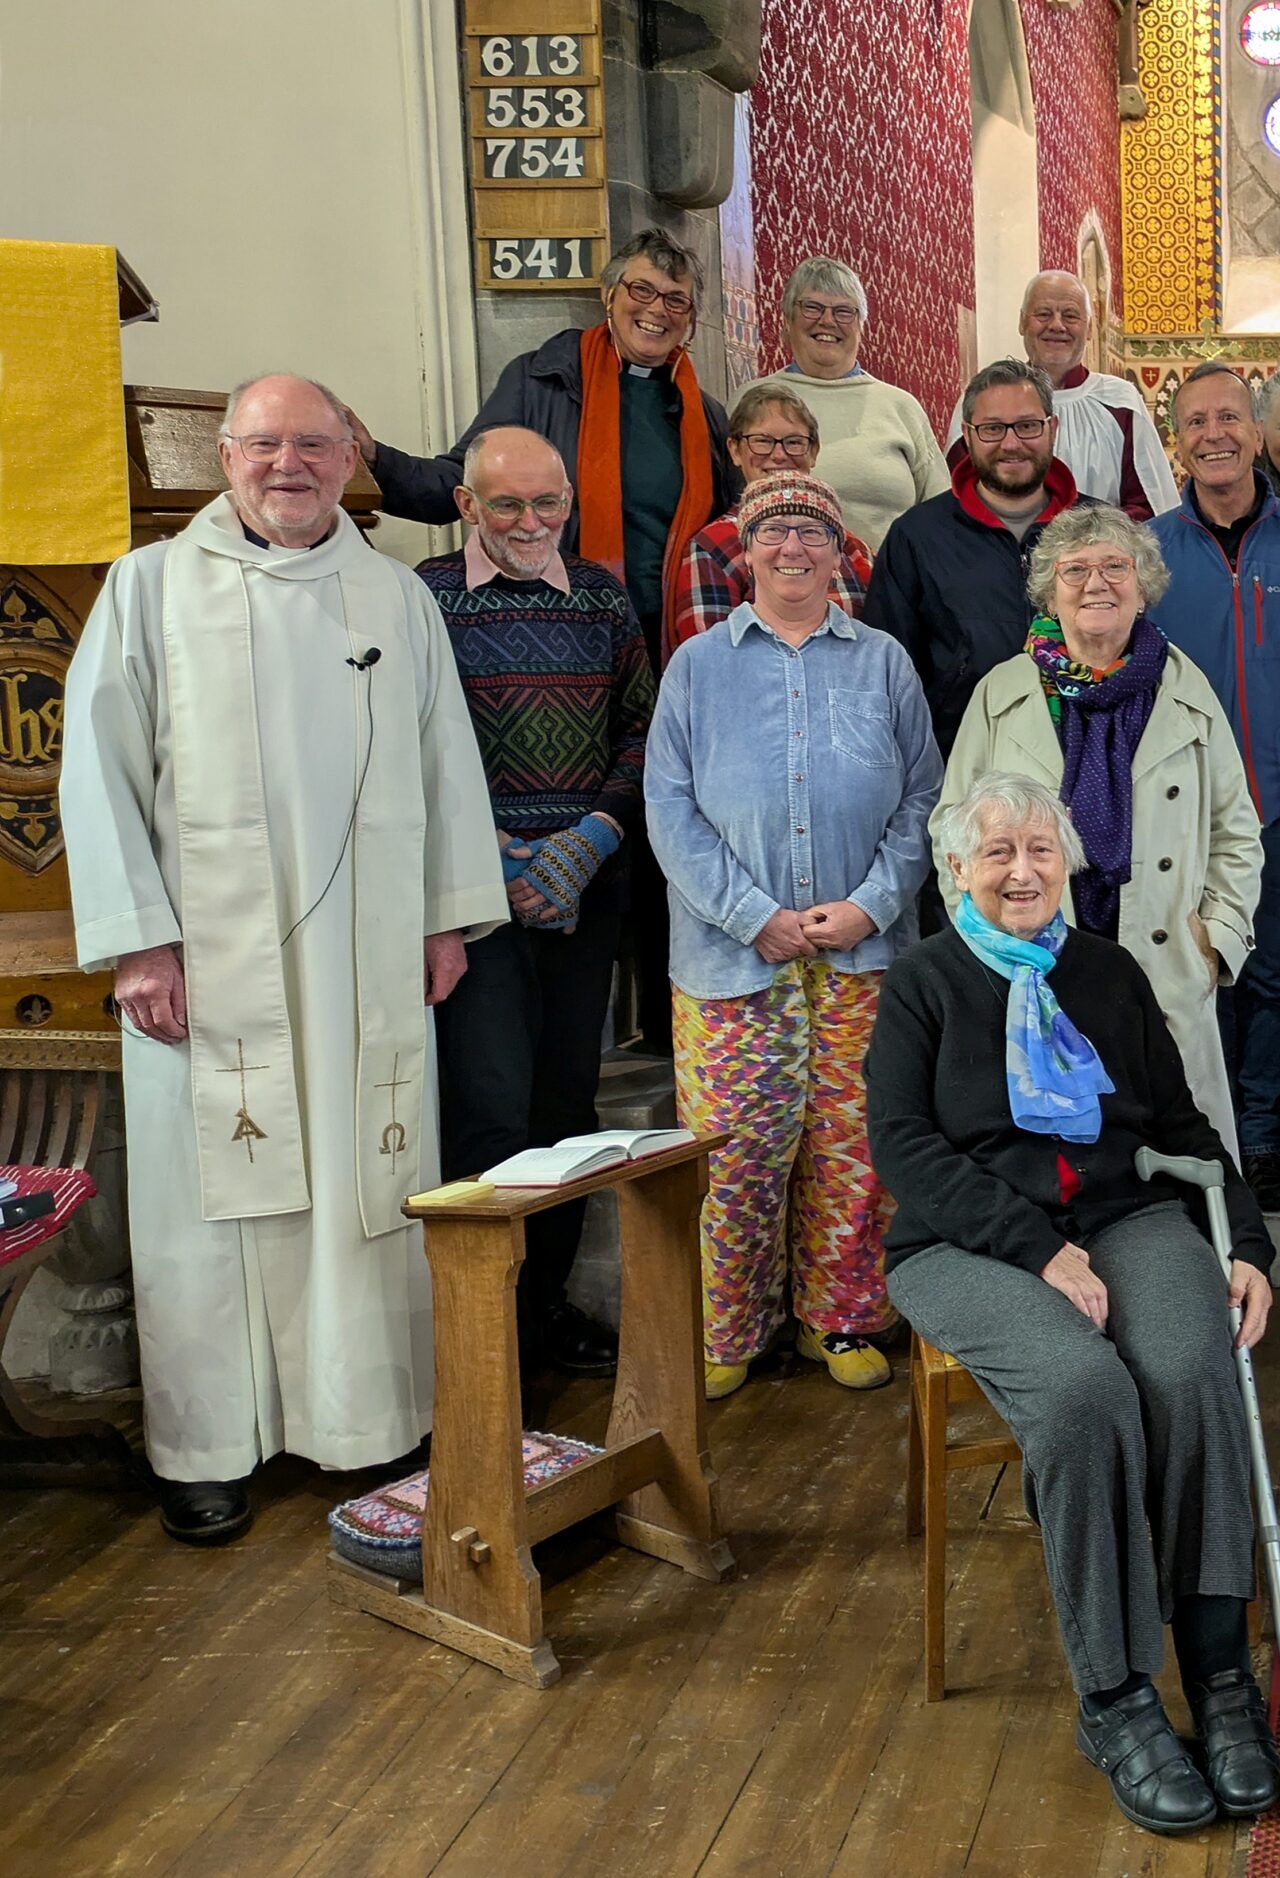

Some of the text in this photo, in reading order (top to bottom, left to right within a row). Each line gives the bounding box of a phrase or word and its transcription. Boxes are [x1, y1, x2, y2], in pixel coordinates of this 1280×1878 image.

[481, 35, 580, 77] 613
[486, 87, 585, 128] 553
[486, 137, 584, 178] 754
[493, 239, 584, 279] 541
